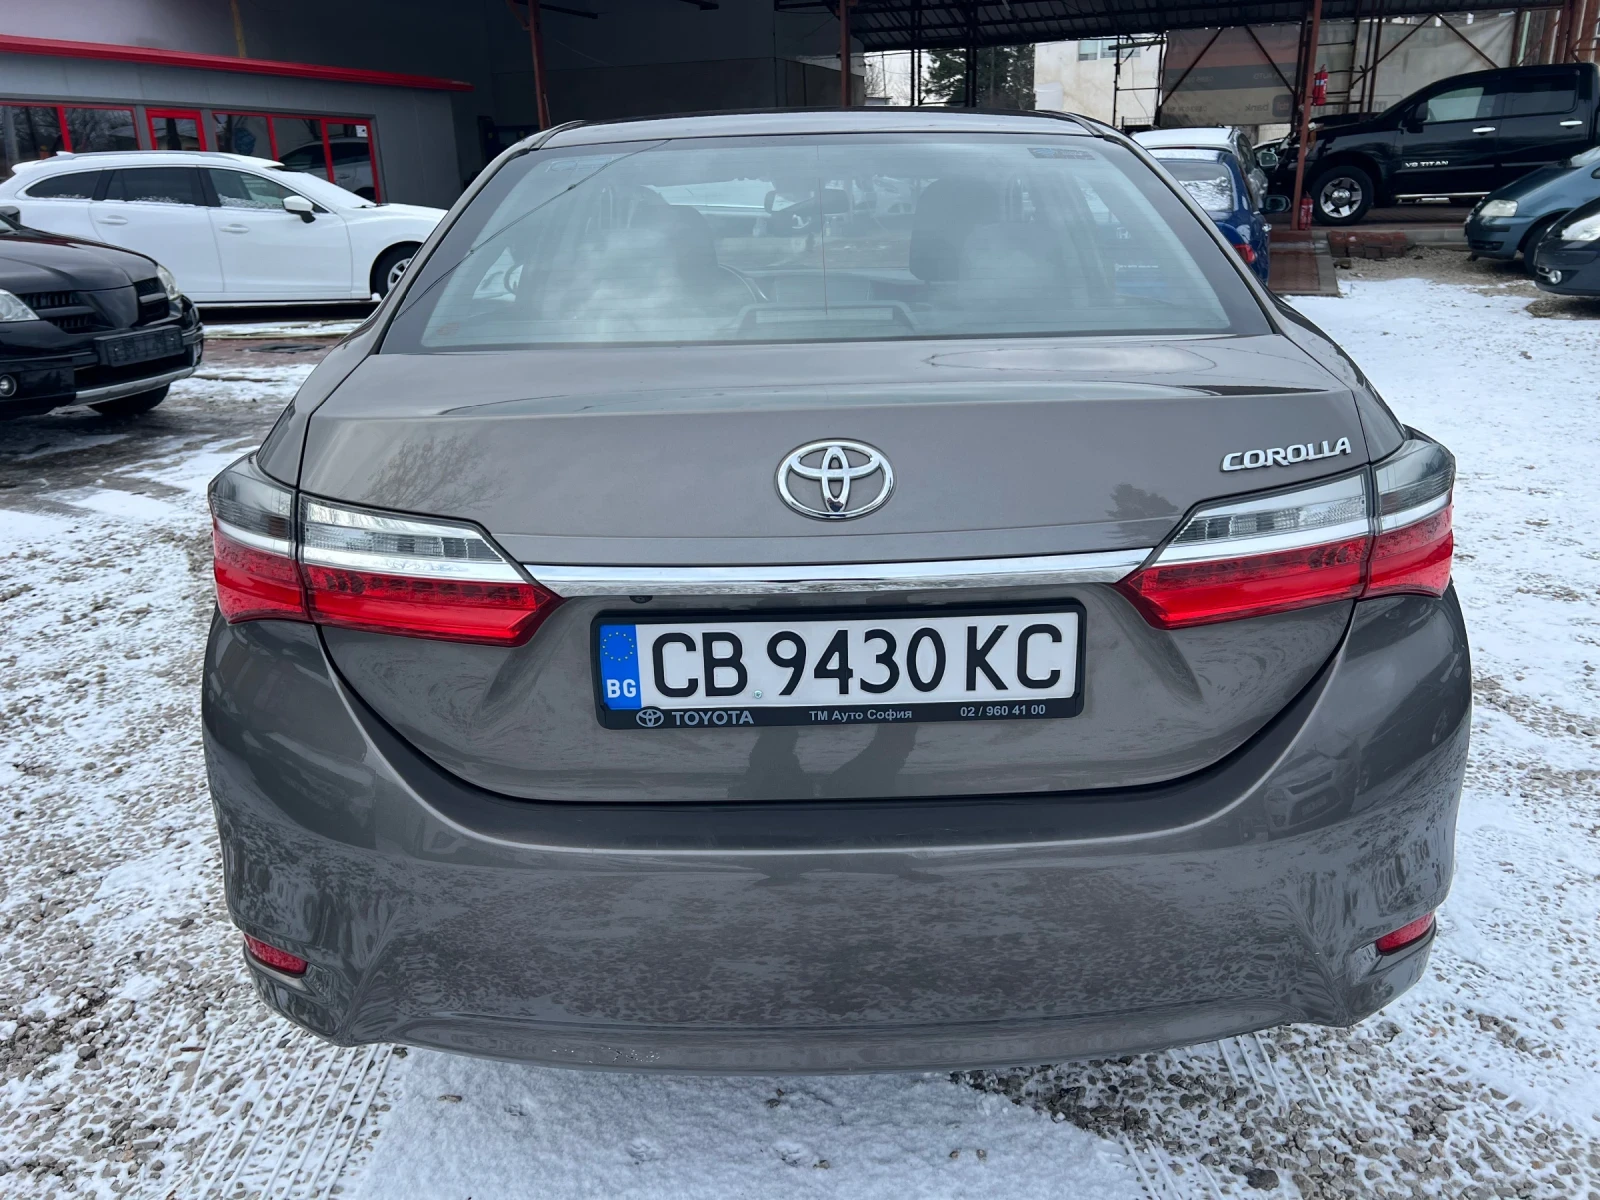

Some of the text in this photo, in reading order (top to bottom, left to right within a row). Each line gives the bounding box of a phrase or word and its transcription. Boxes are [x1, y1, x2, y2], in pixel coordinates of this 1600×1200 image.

[1221, 436, 1352, 471] COROLLA
[652, 623, 1063, 698] CB 9430 KC
[606, 679, 637, 698] BG
[672, 710, 755, 726] TOYOTA
[831, 710, 864, 723] Ауто
[867, 708, 913, 721] София
[960, 704, 1046, 717] 02 / 960 41 00
